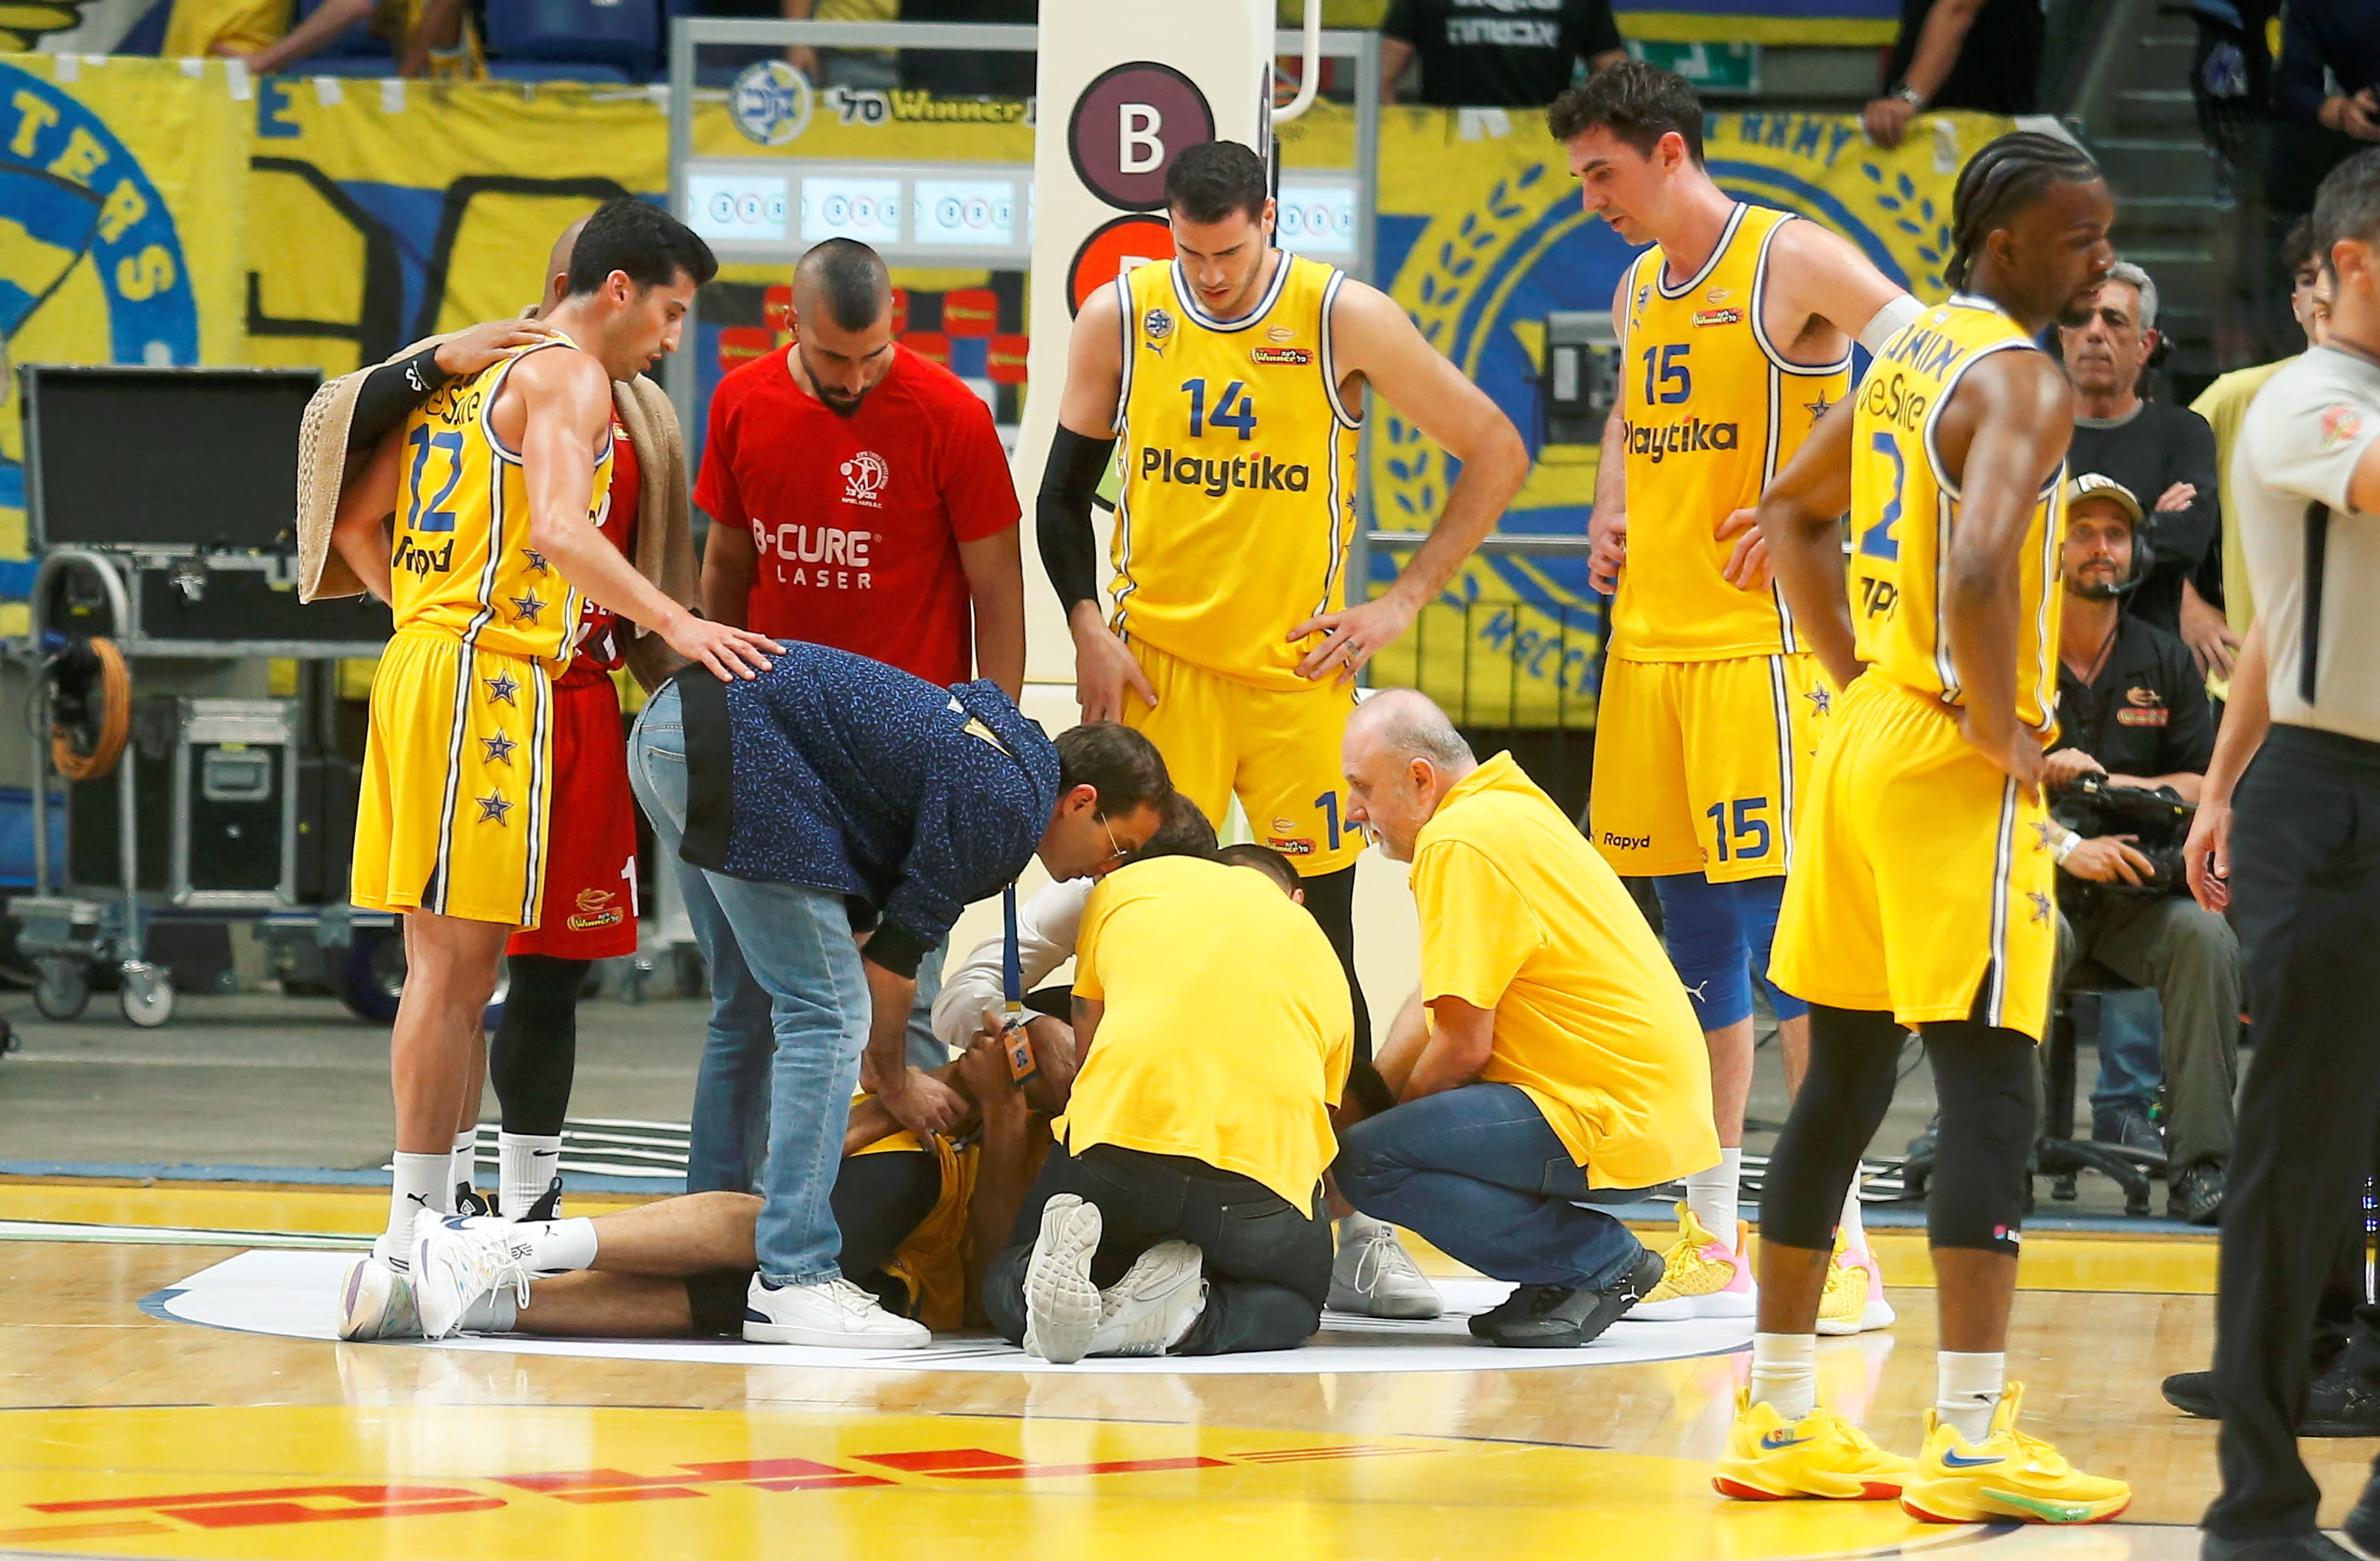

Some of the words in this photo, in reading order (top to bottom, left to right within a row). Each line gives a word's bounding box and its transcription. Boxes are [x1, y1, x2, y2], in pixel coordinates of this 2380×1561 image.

[889, 87, 1024, 123] Winner
[1119, 103, 1165, 174] B
[1255, 349, 1297, 362] Winner
[1643, 344, 1692, 405] 15
[1181, 378, 1257, 441] 14
[409, 422, 464, 532] 12
[1142, 447, 1310, 497] Playtika
[1860, 431, 1905, 562] 2
[776, 564, 872, 589] LASER
[1314, 791, 1362, 851] 1
[1603, 832, 1651, 850] Rapyd
[1706, 797, 1771, 862] 15
[575, 915, 611, 928] Winner
